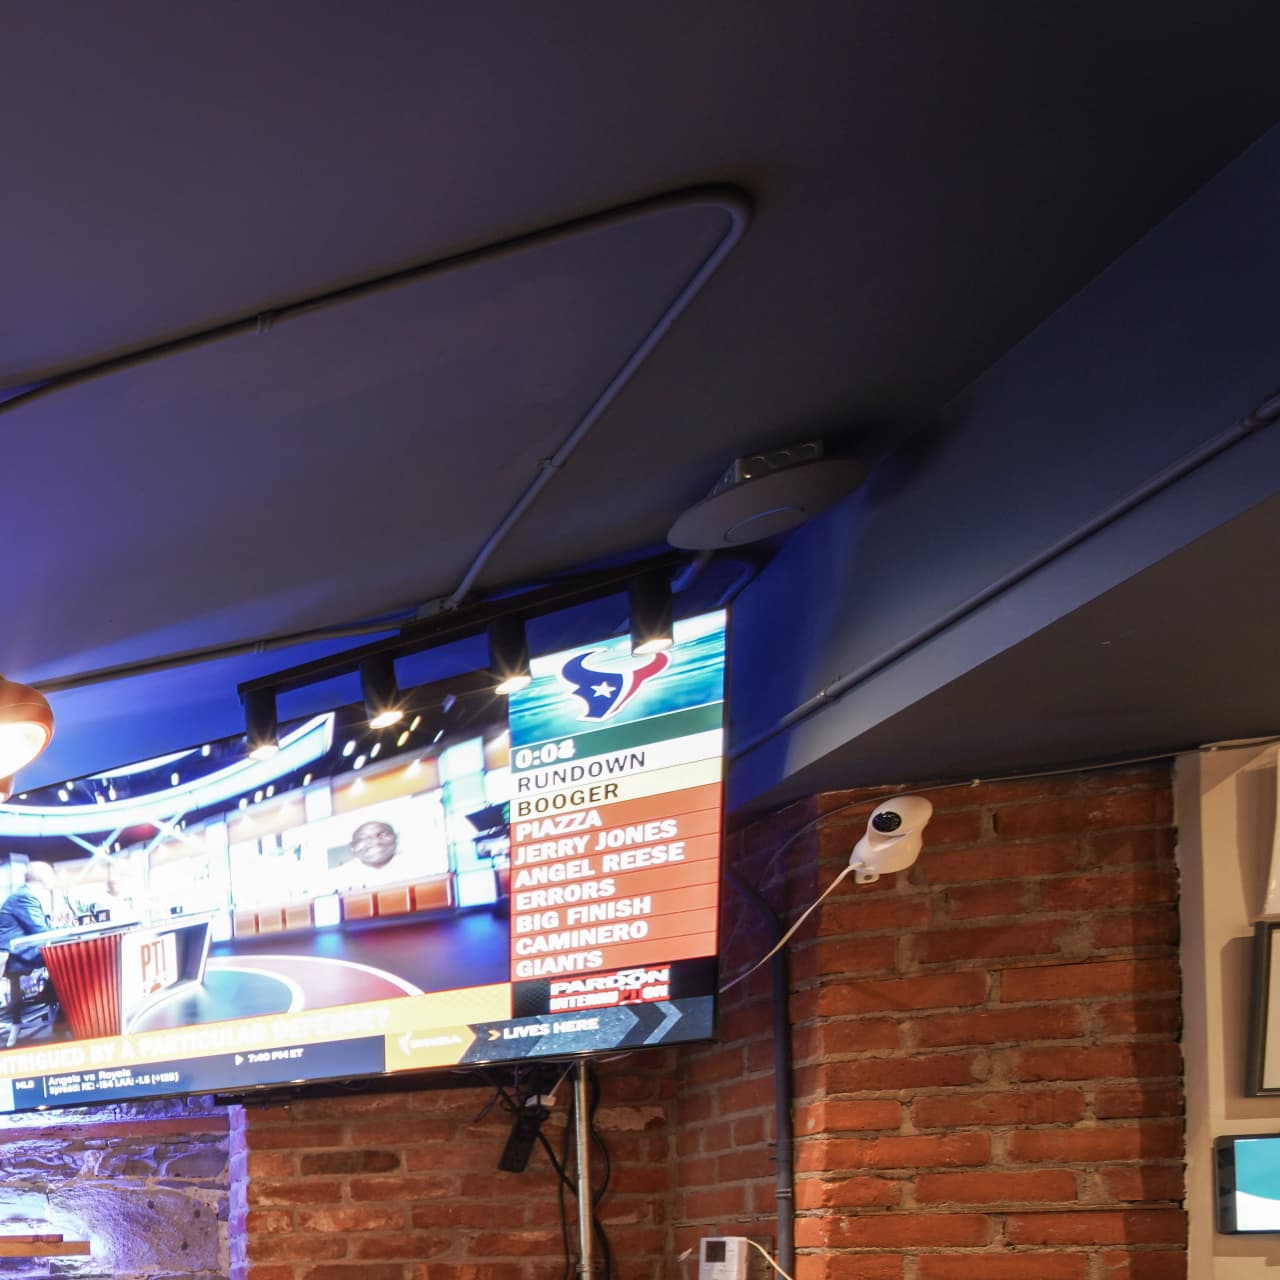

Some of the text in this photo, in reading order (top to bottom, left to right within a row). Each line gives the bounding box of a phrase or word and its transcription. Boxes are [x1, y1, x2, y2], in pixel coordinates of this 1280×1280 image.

[518, 751, 646, 793] RUNDOWN
[518, 783, 619, 817] BOOGER
[516, 809, 602, 842] PIAZZA
[514, 819, 678, 866] JERRY JONES
[514, 842, 685, 889] ANGEL REESE
[516, 879, 616, 911] ERRORS
[516, 896, 652, 933] BIG FINISH
[515, 921, 648, 956] CAMINERO
[515, 951, 603, 978] GIANTS
[550, 968, 669, 996] PARDON
[503, 1017, 600, 1040] LIVES HERE
[90, 1045, 114, 1064] BY
[122, 1042, 138, 1060] A
[49, 1074, 81, 1087] Angels
[99, 1068, 132, 1081] Royals
